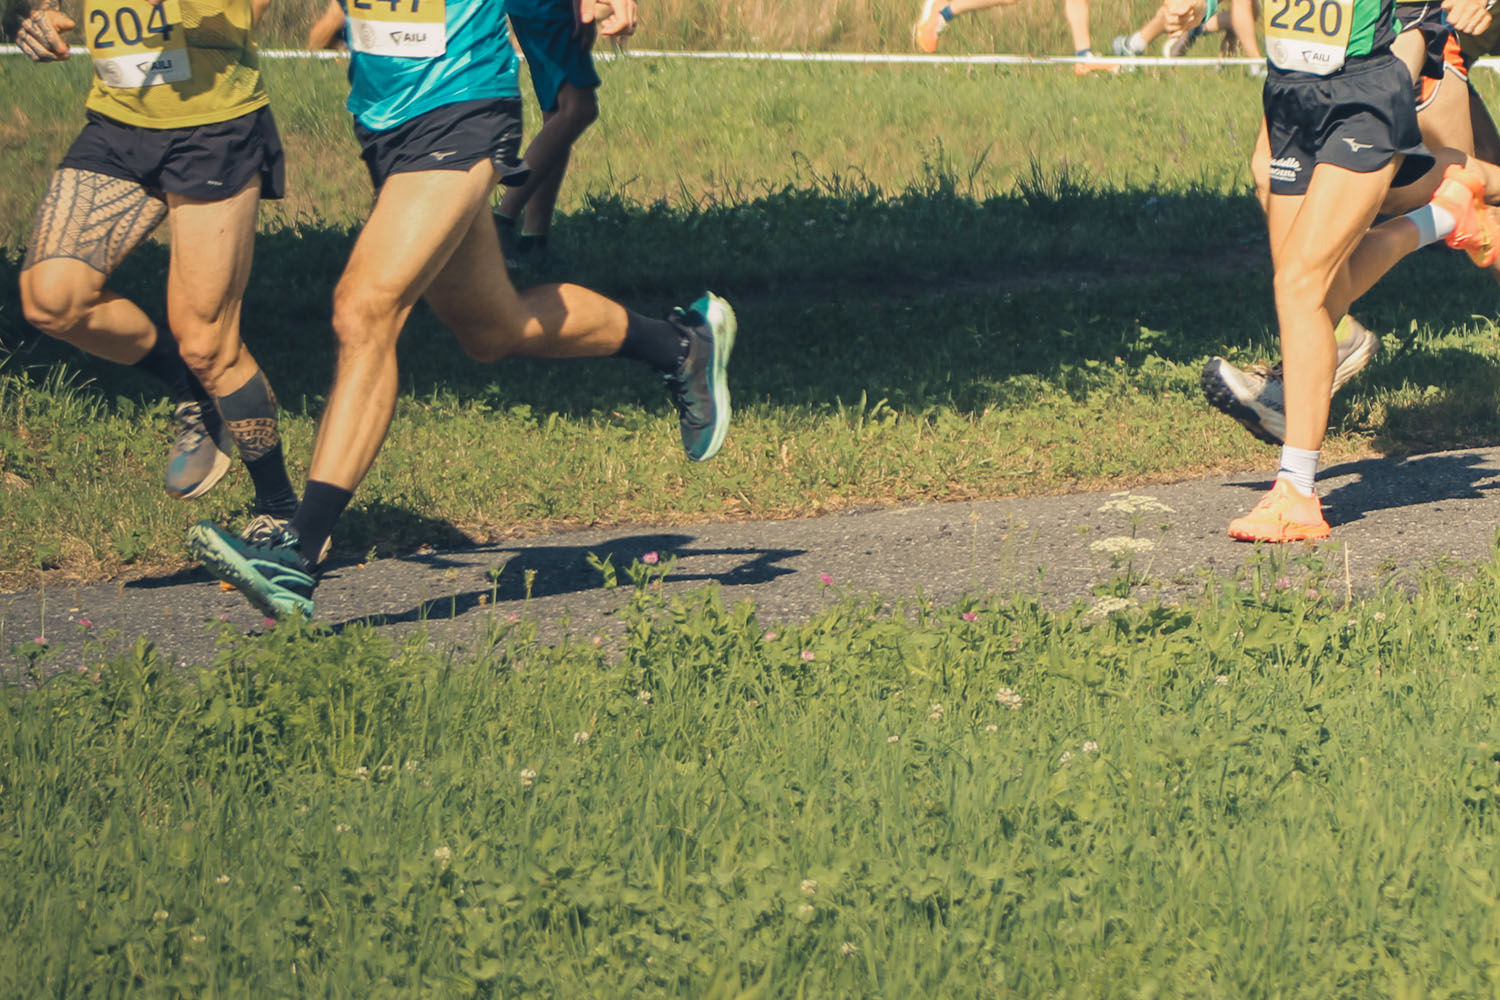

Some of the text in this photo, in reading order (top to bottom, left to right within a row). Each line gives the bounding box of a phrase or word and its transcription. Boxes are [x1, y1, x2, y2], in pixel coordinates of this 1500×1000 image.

[90, 3, 173, 49] 204
[404, 33, 426, 42] AILI
[1312, 52, 1331, 62] AILI
